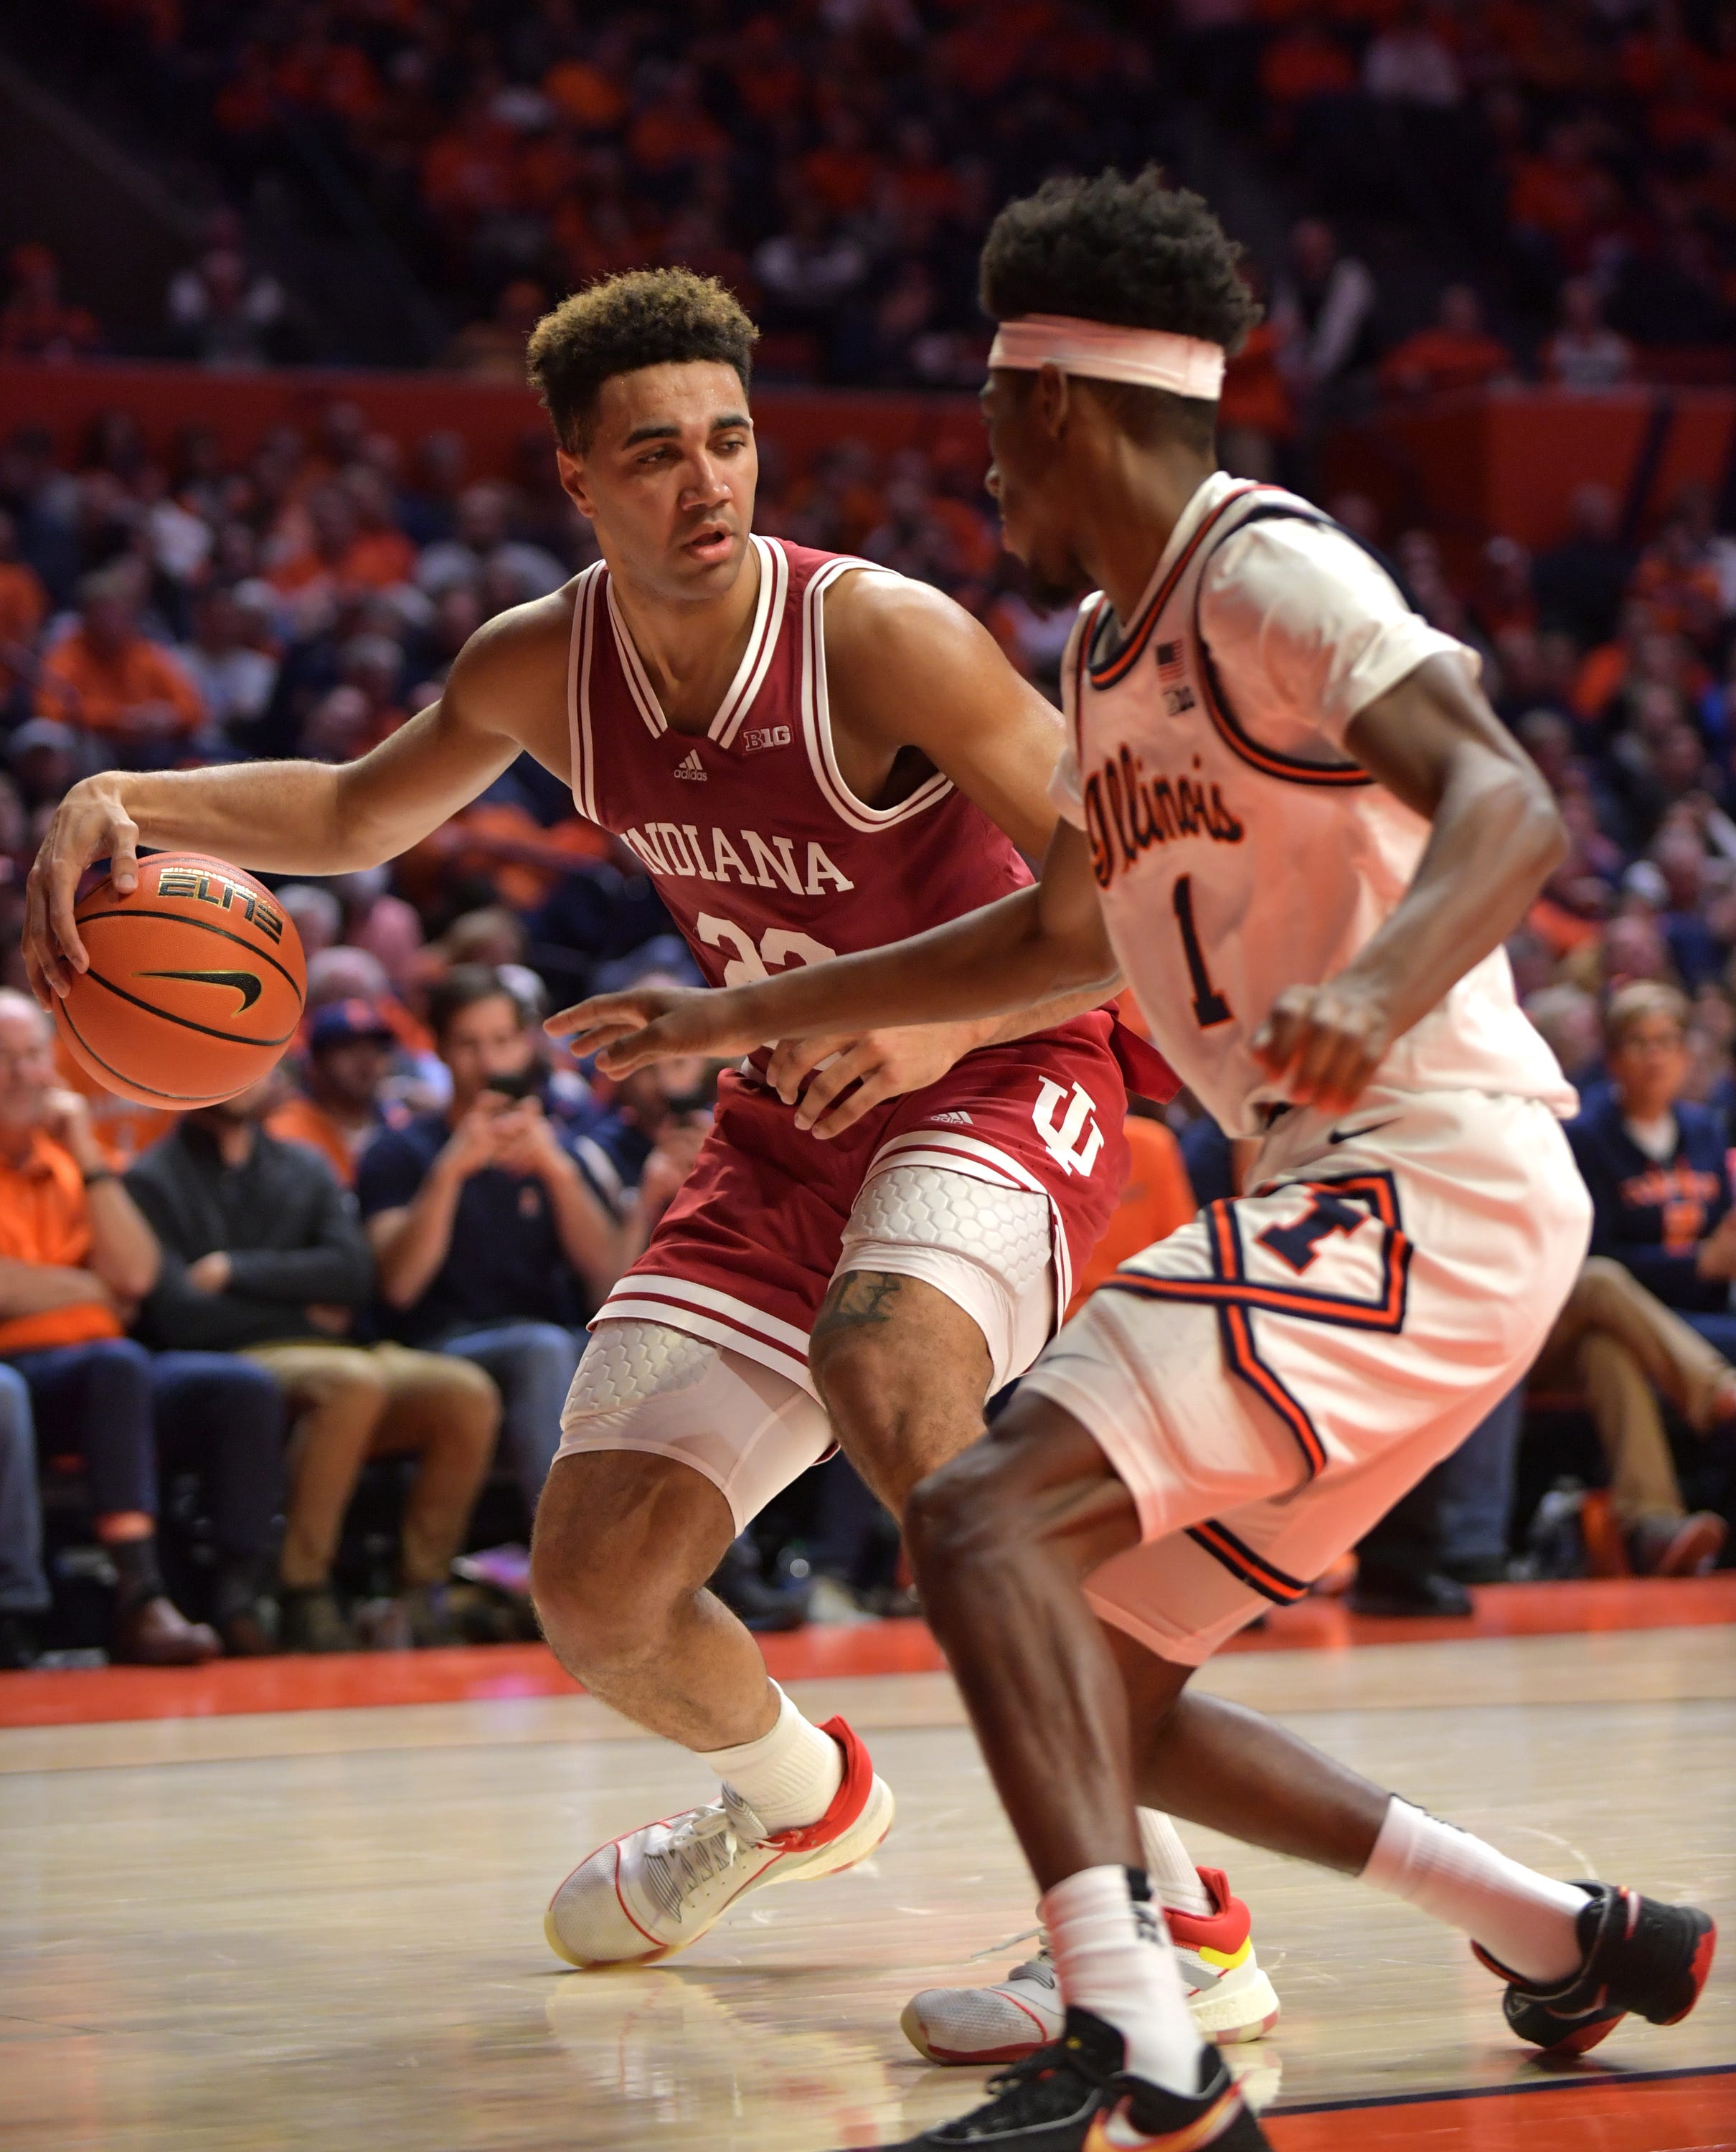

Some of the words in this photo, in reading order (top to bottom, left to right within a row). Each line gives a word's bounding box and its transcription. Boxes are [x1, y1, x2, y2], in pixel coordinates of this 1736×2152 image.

[674, 769, 708, 782] adidas
[1084, 742, 1245, 891] Illinois
[157, 872, 283, 945] ELITE
[1172, 871, 1235, 1030] 1
